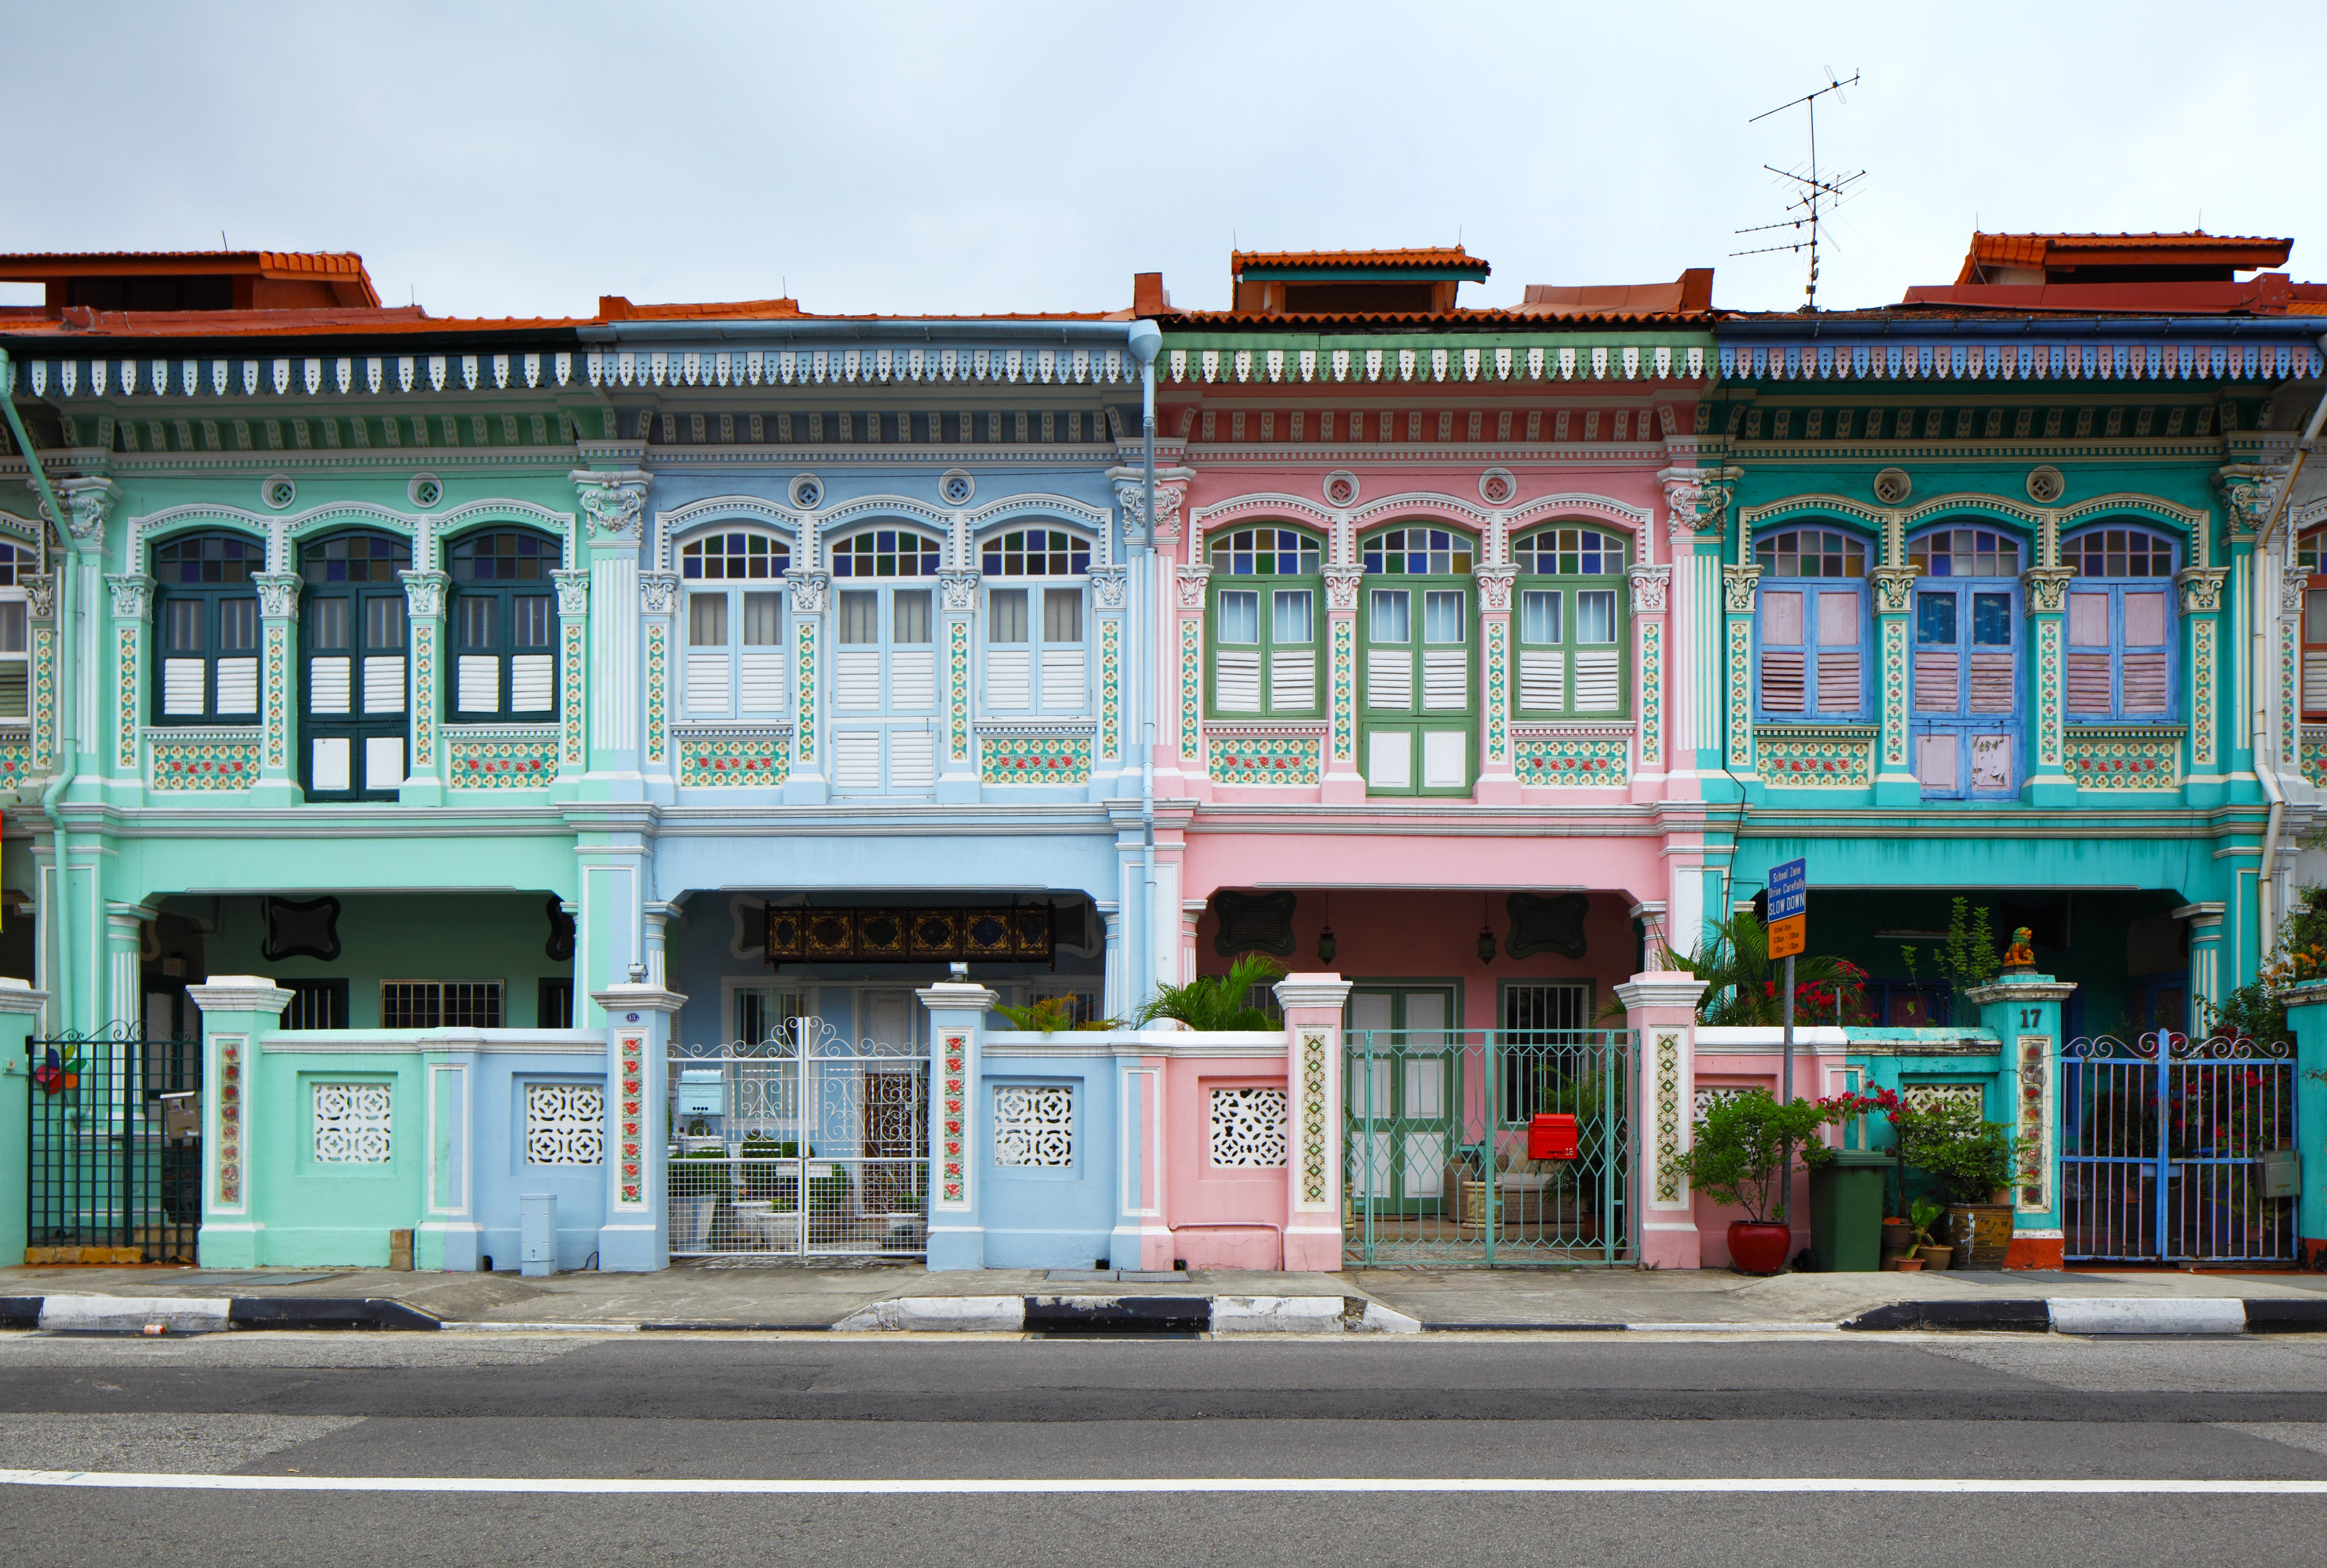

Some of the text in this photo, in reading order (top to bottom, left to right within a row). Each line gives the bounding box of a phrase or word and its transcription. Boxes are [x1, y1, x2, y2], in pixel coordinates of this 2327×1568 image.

[1773, 866, 1801, 883] School Zone
[1769, 878, 1804, 898] Drive Carefully
[1769, 892, 1805, 916] SLOW DOWN
[1774, 925, 1783, 933] School
[2020, 1009, 2042, 1028] 17
[1565, 1148, 1573, 1156] 15
